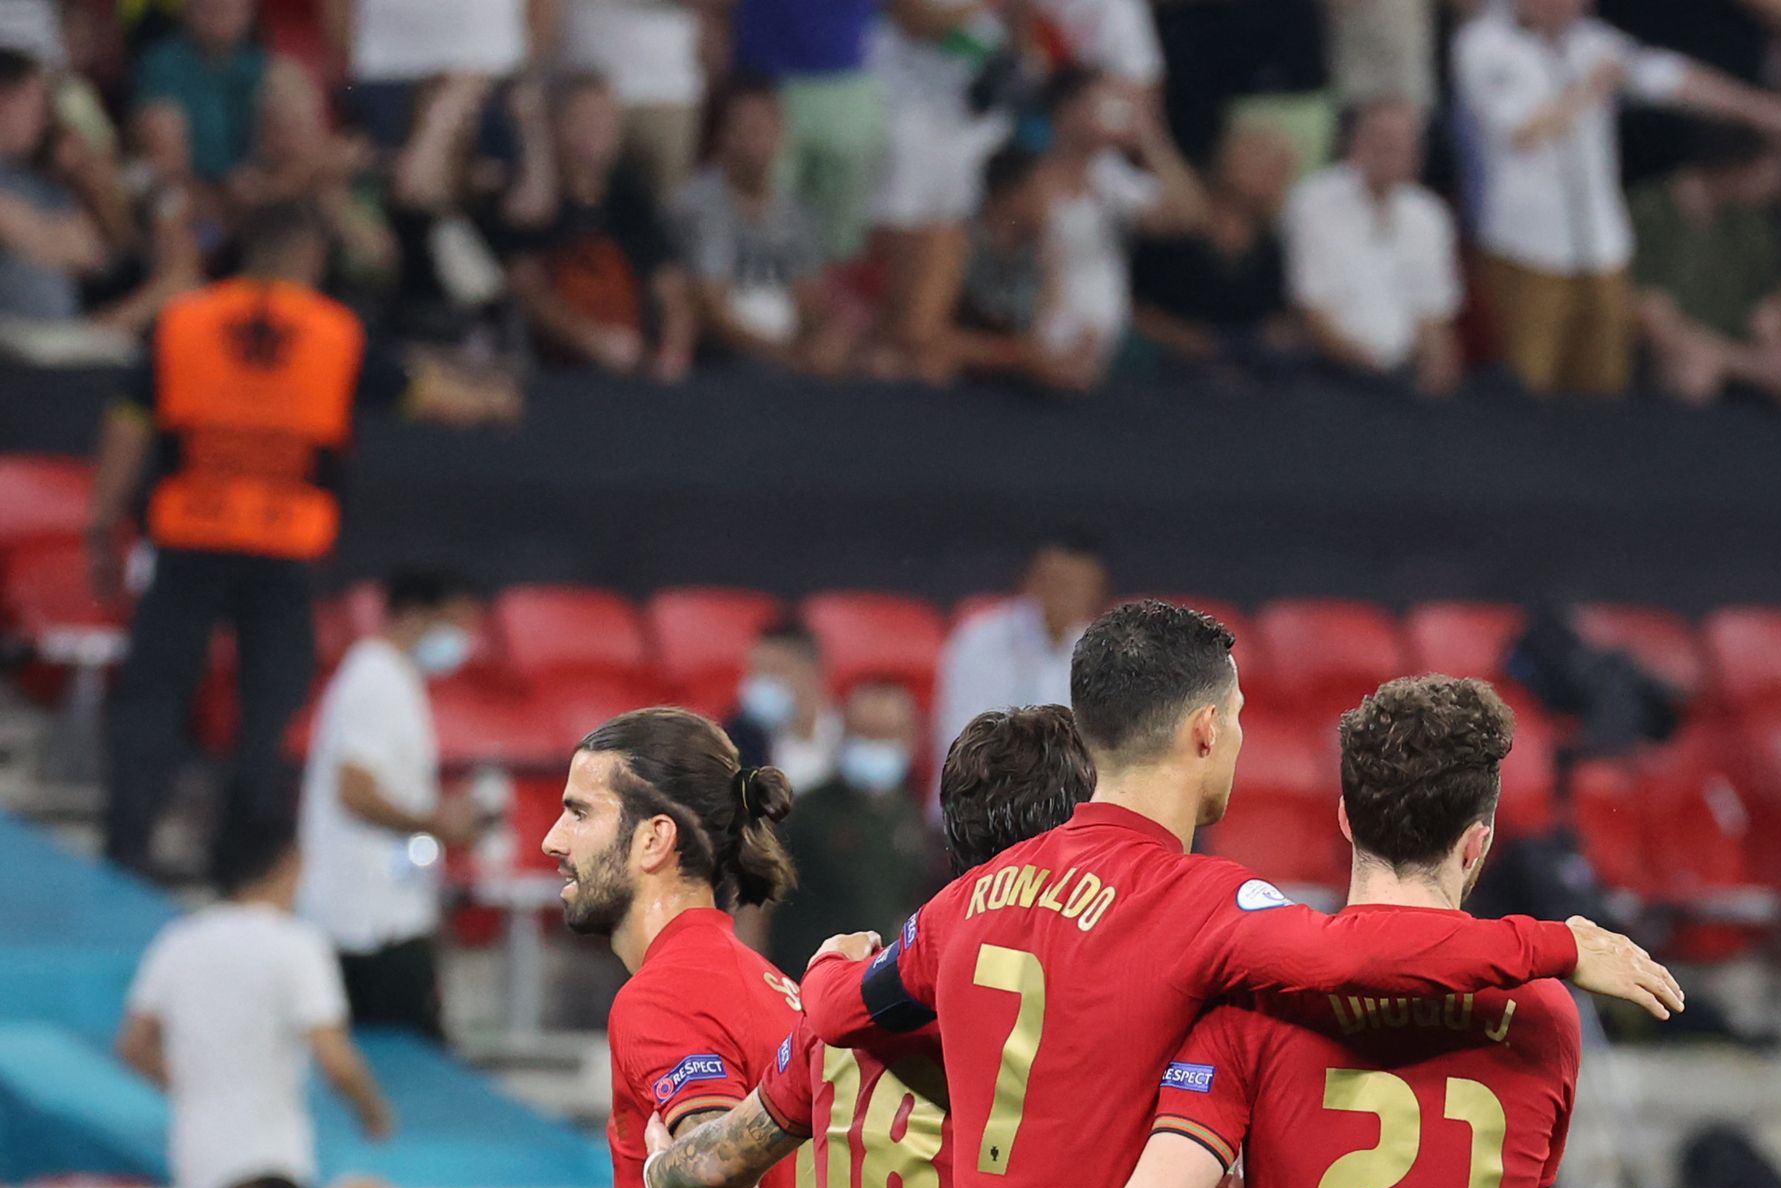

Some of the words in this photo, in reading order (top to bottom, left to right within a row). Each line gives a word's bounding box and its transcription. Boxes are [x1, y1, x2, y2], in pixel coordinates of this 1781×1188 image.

[965, 864, 1117, 932] RONLDO
[672, 1060, 723, 1086] RESPECT
[973, 943, 1046, 1176] 7
